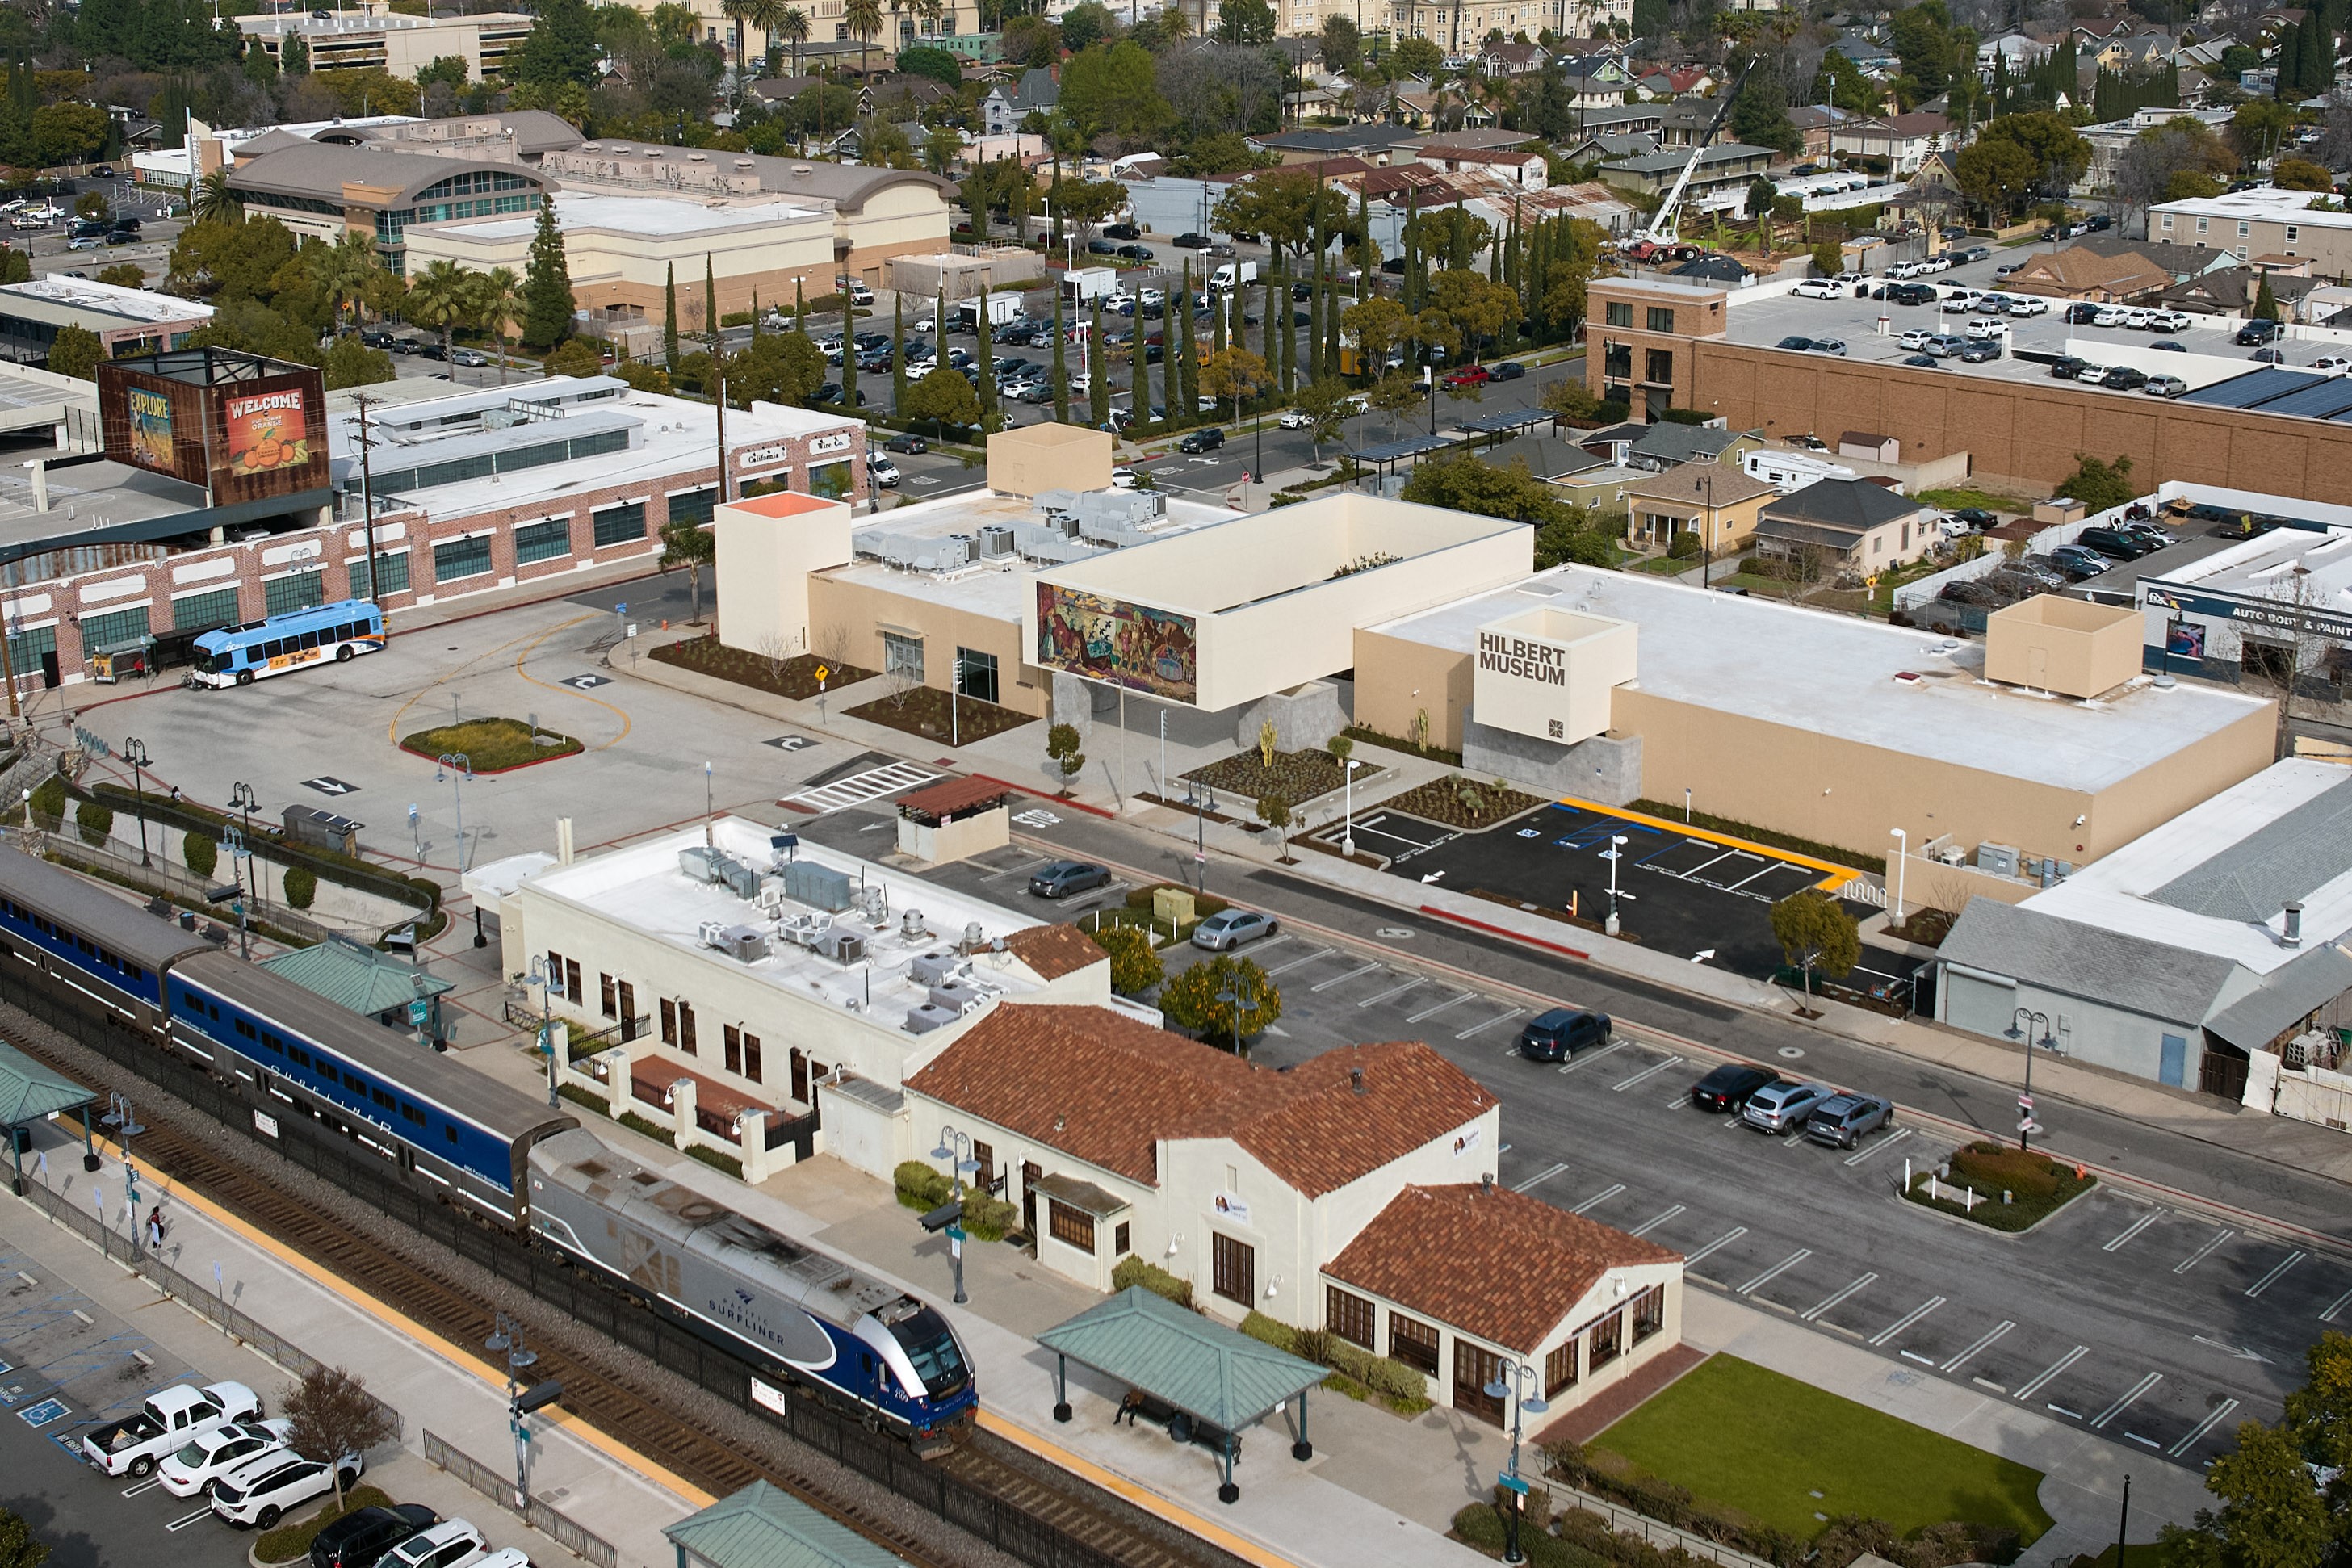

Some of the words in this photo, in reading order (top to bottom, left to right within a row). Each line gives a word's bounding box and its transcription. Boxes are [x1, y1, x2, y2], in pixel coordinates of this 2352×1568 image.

[130, 390, 168, 419] EXPLORE
[229, 392, 301, 420] WELCOME
[251, 420, 283, 430] ORANGE
[748, 452, 779, 463] California
[821, 441, 836, 450] Wire
[2232, 607, 2266, 620] AUTO
[2304, 619, 2313, 630] &
[2317, 622, 2352, 637] PAINT
[1480, 632, 1566, 667] HILBERT
[1480, 651, 1566, 686] MUSEUM
[270, 1064, 392, 1135] SURFLINER
[709, 1298, 784, 1346] SURFLINER
[723, 1298, 768, 1327] PACIFIC
